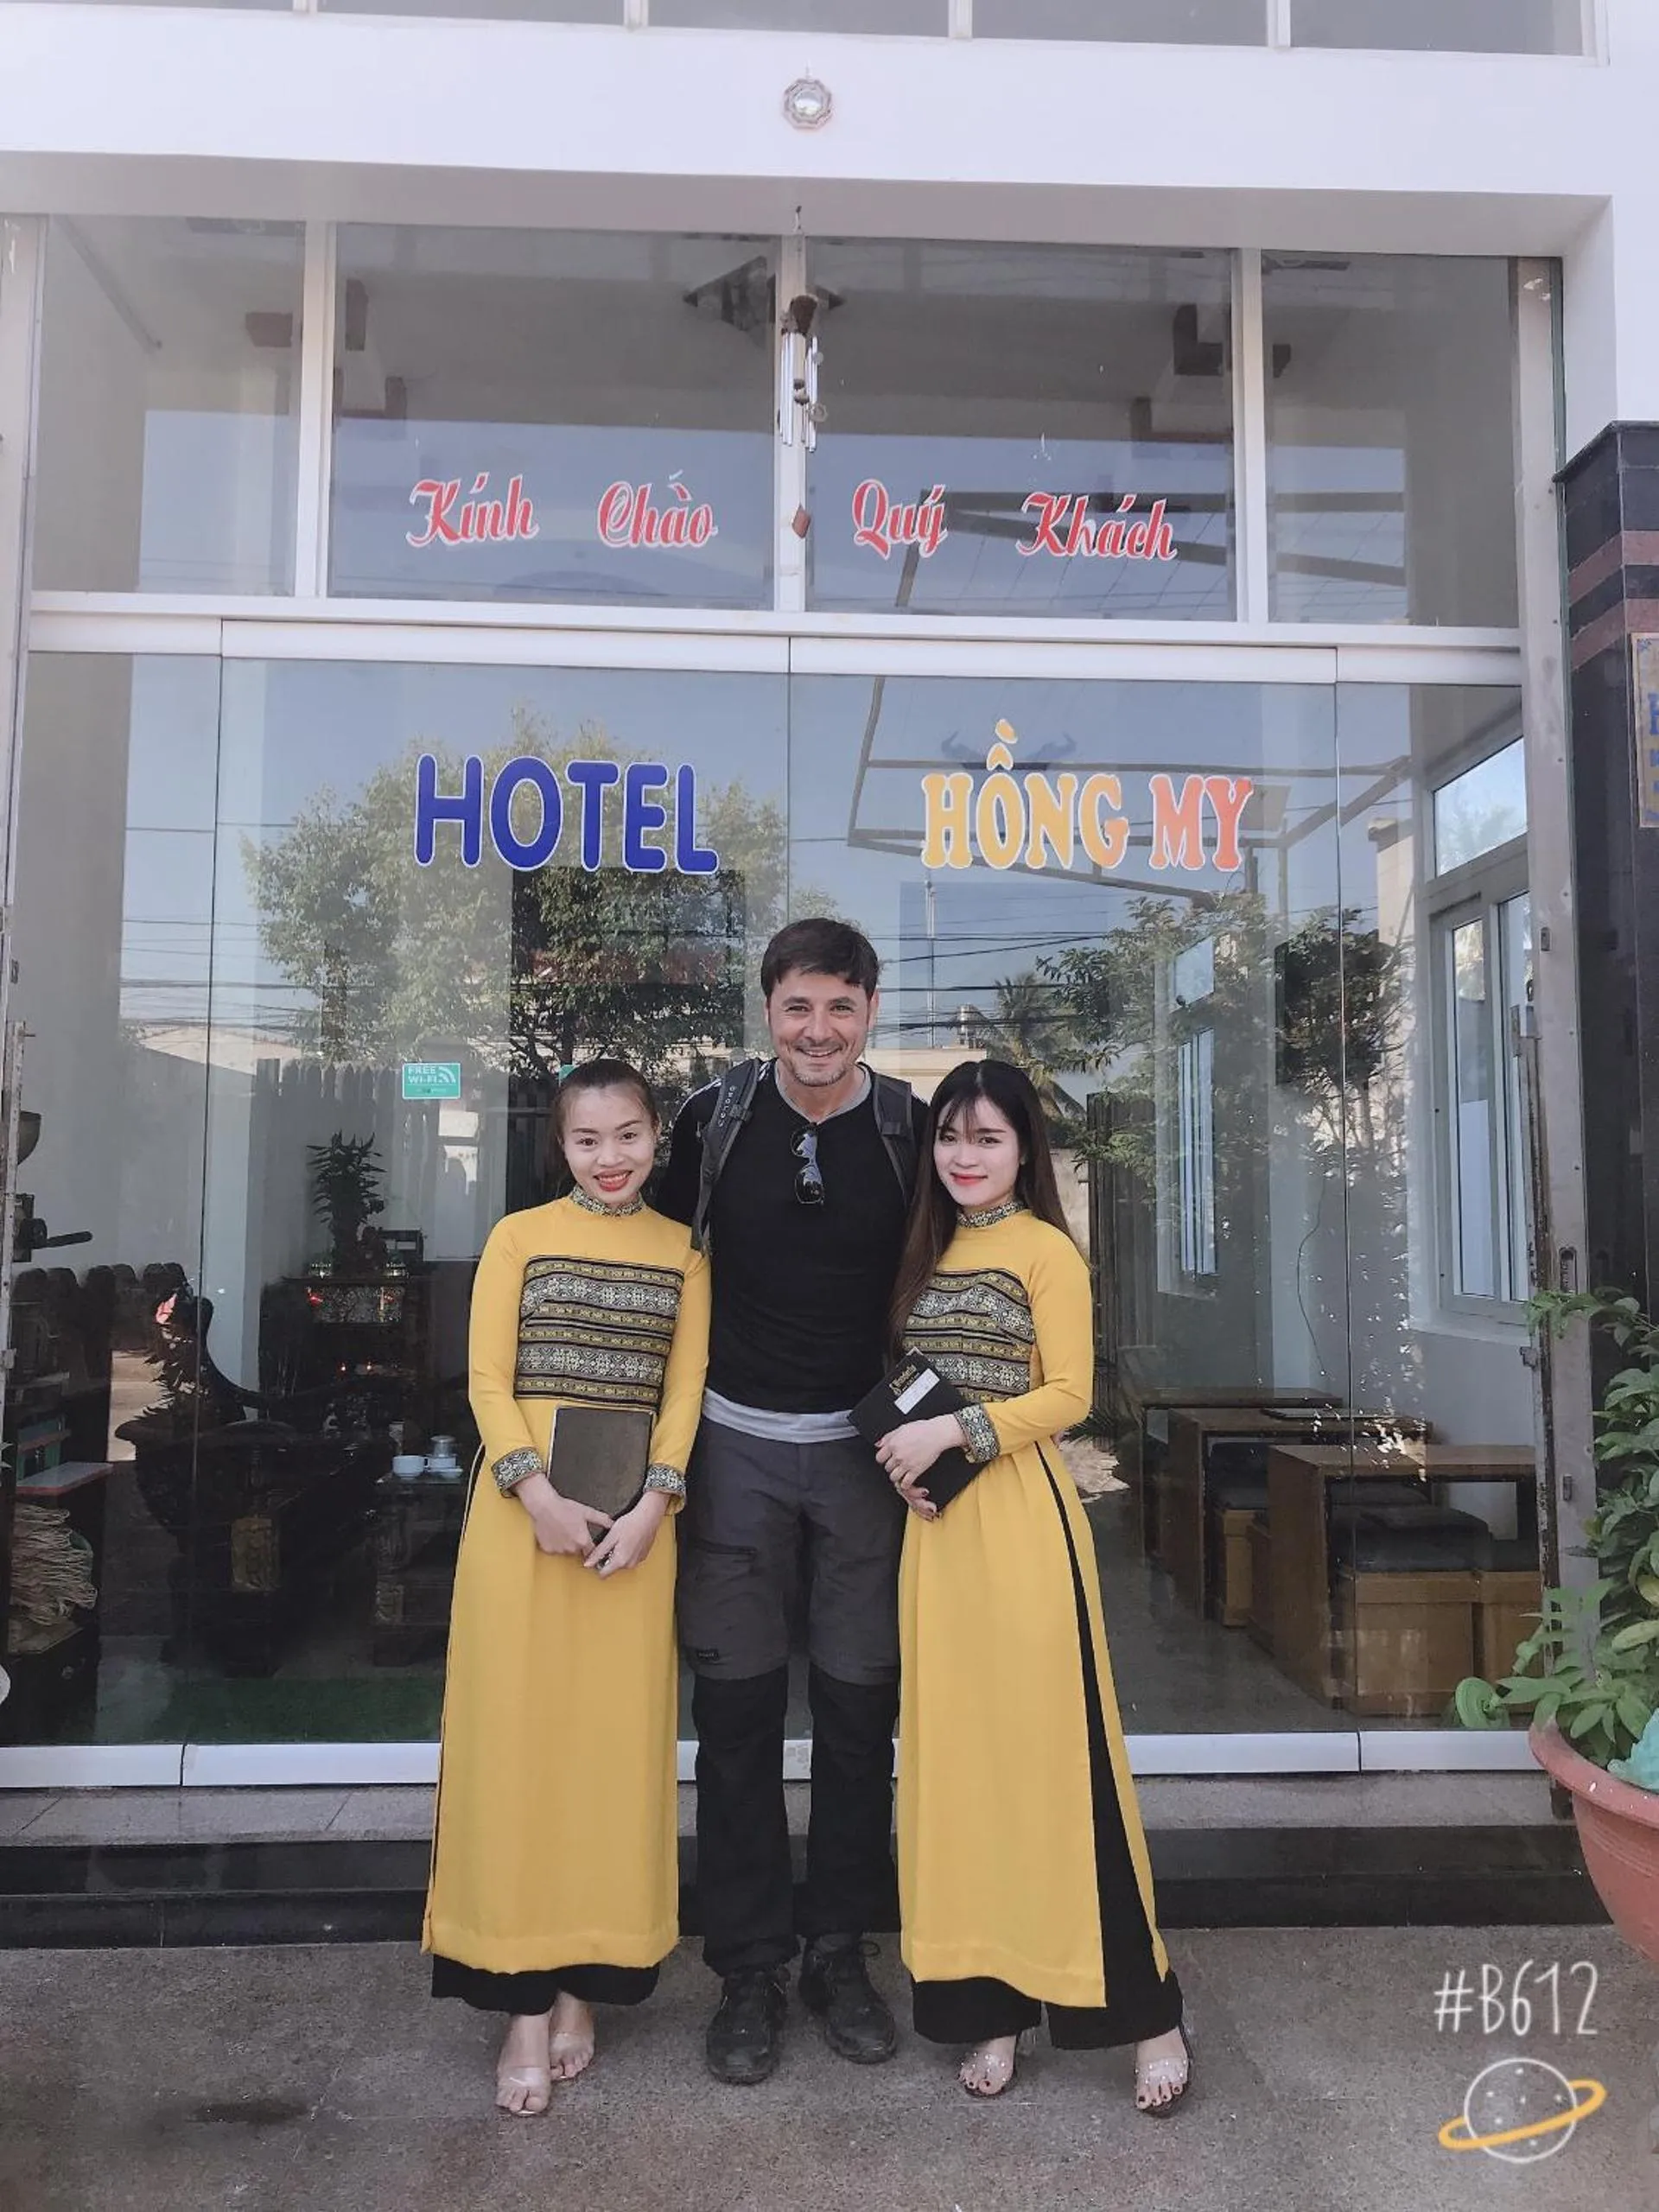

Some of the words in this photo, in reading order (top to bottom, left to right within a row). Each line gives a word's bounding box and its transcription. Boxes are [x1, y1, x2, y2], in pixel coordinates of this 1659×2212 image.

[406, 471, 539, 547] Kính
[597, 480, 717, 548] Chào
[852, 478, 948, 560] Quý
[1015, 492, 1177, 561] Khách
[414, 753, 719, 874] HOTEL
[921, 718, 1130, 869] HỒNG
[1148, 773, 1254, 871] MY
[408, 1065, 436, 1074] FREE
